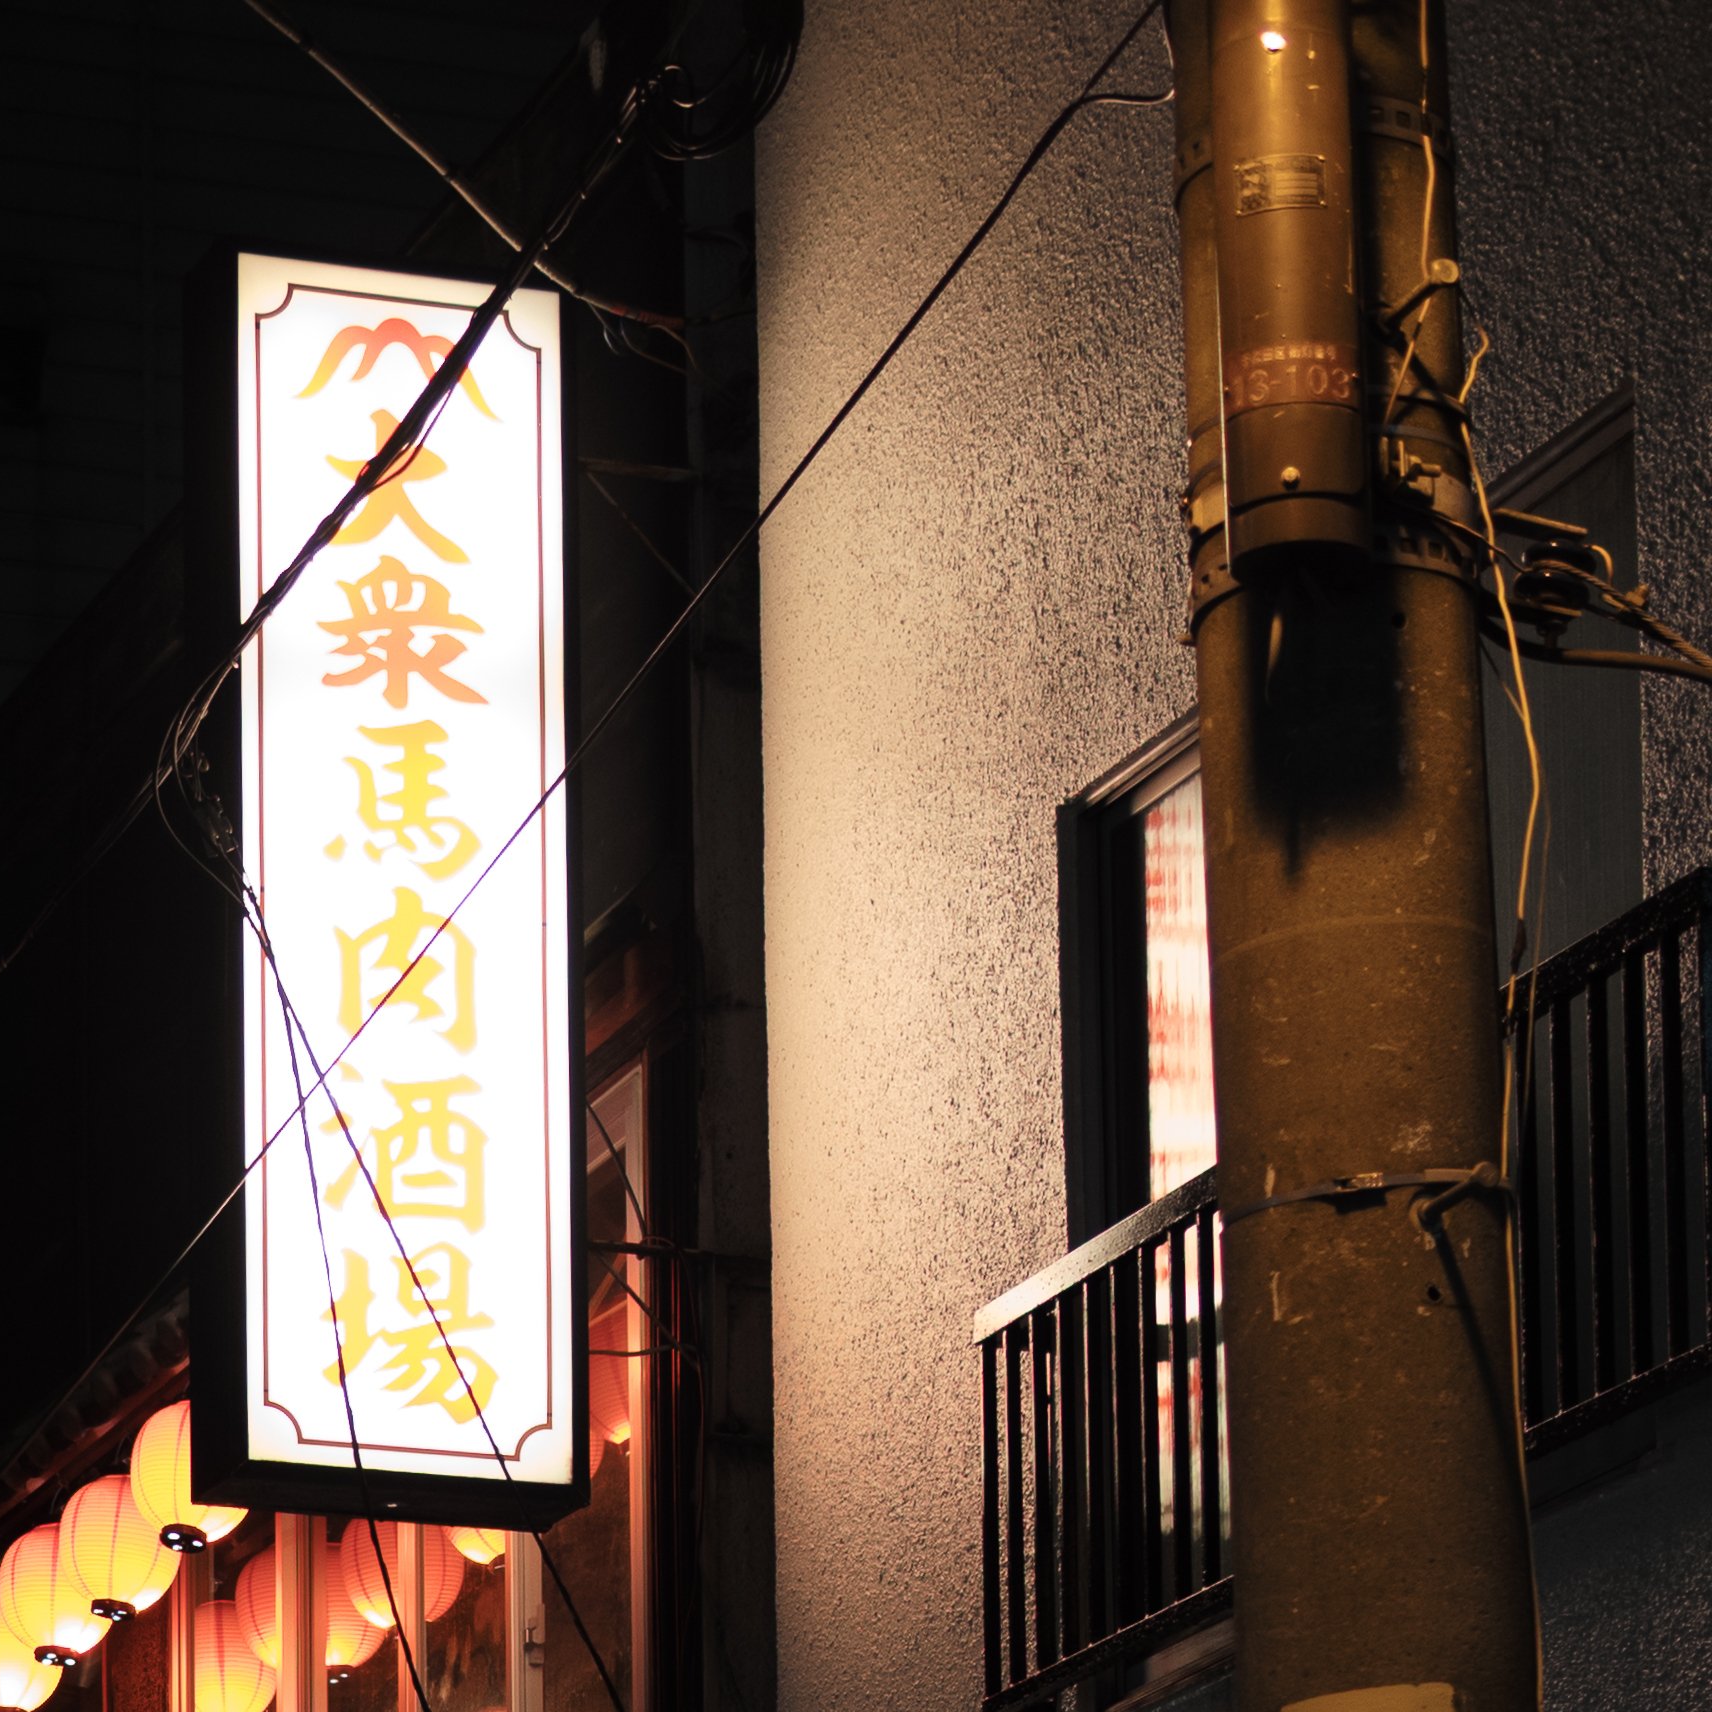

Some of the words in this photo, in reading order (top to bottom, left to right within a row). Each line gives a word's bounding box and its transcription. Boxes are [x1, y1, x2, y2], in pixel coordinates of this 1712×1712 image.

[316, 408, 499, 1426] 大衆馬肉酒場
